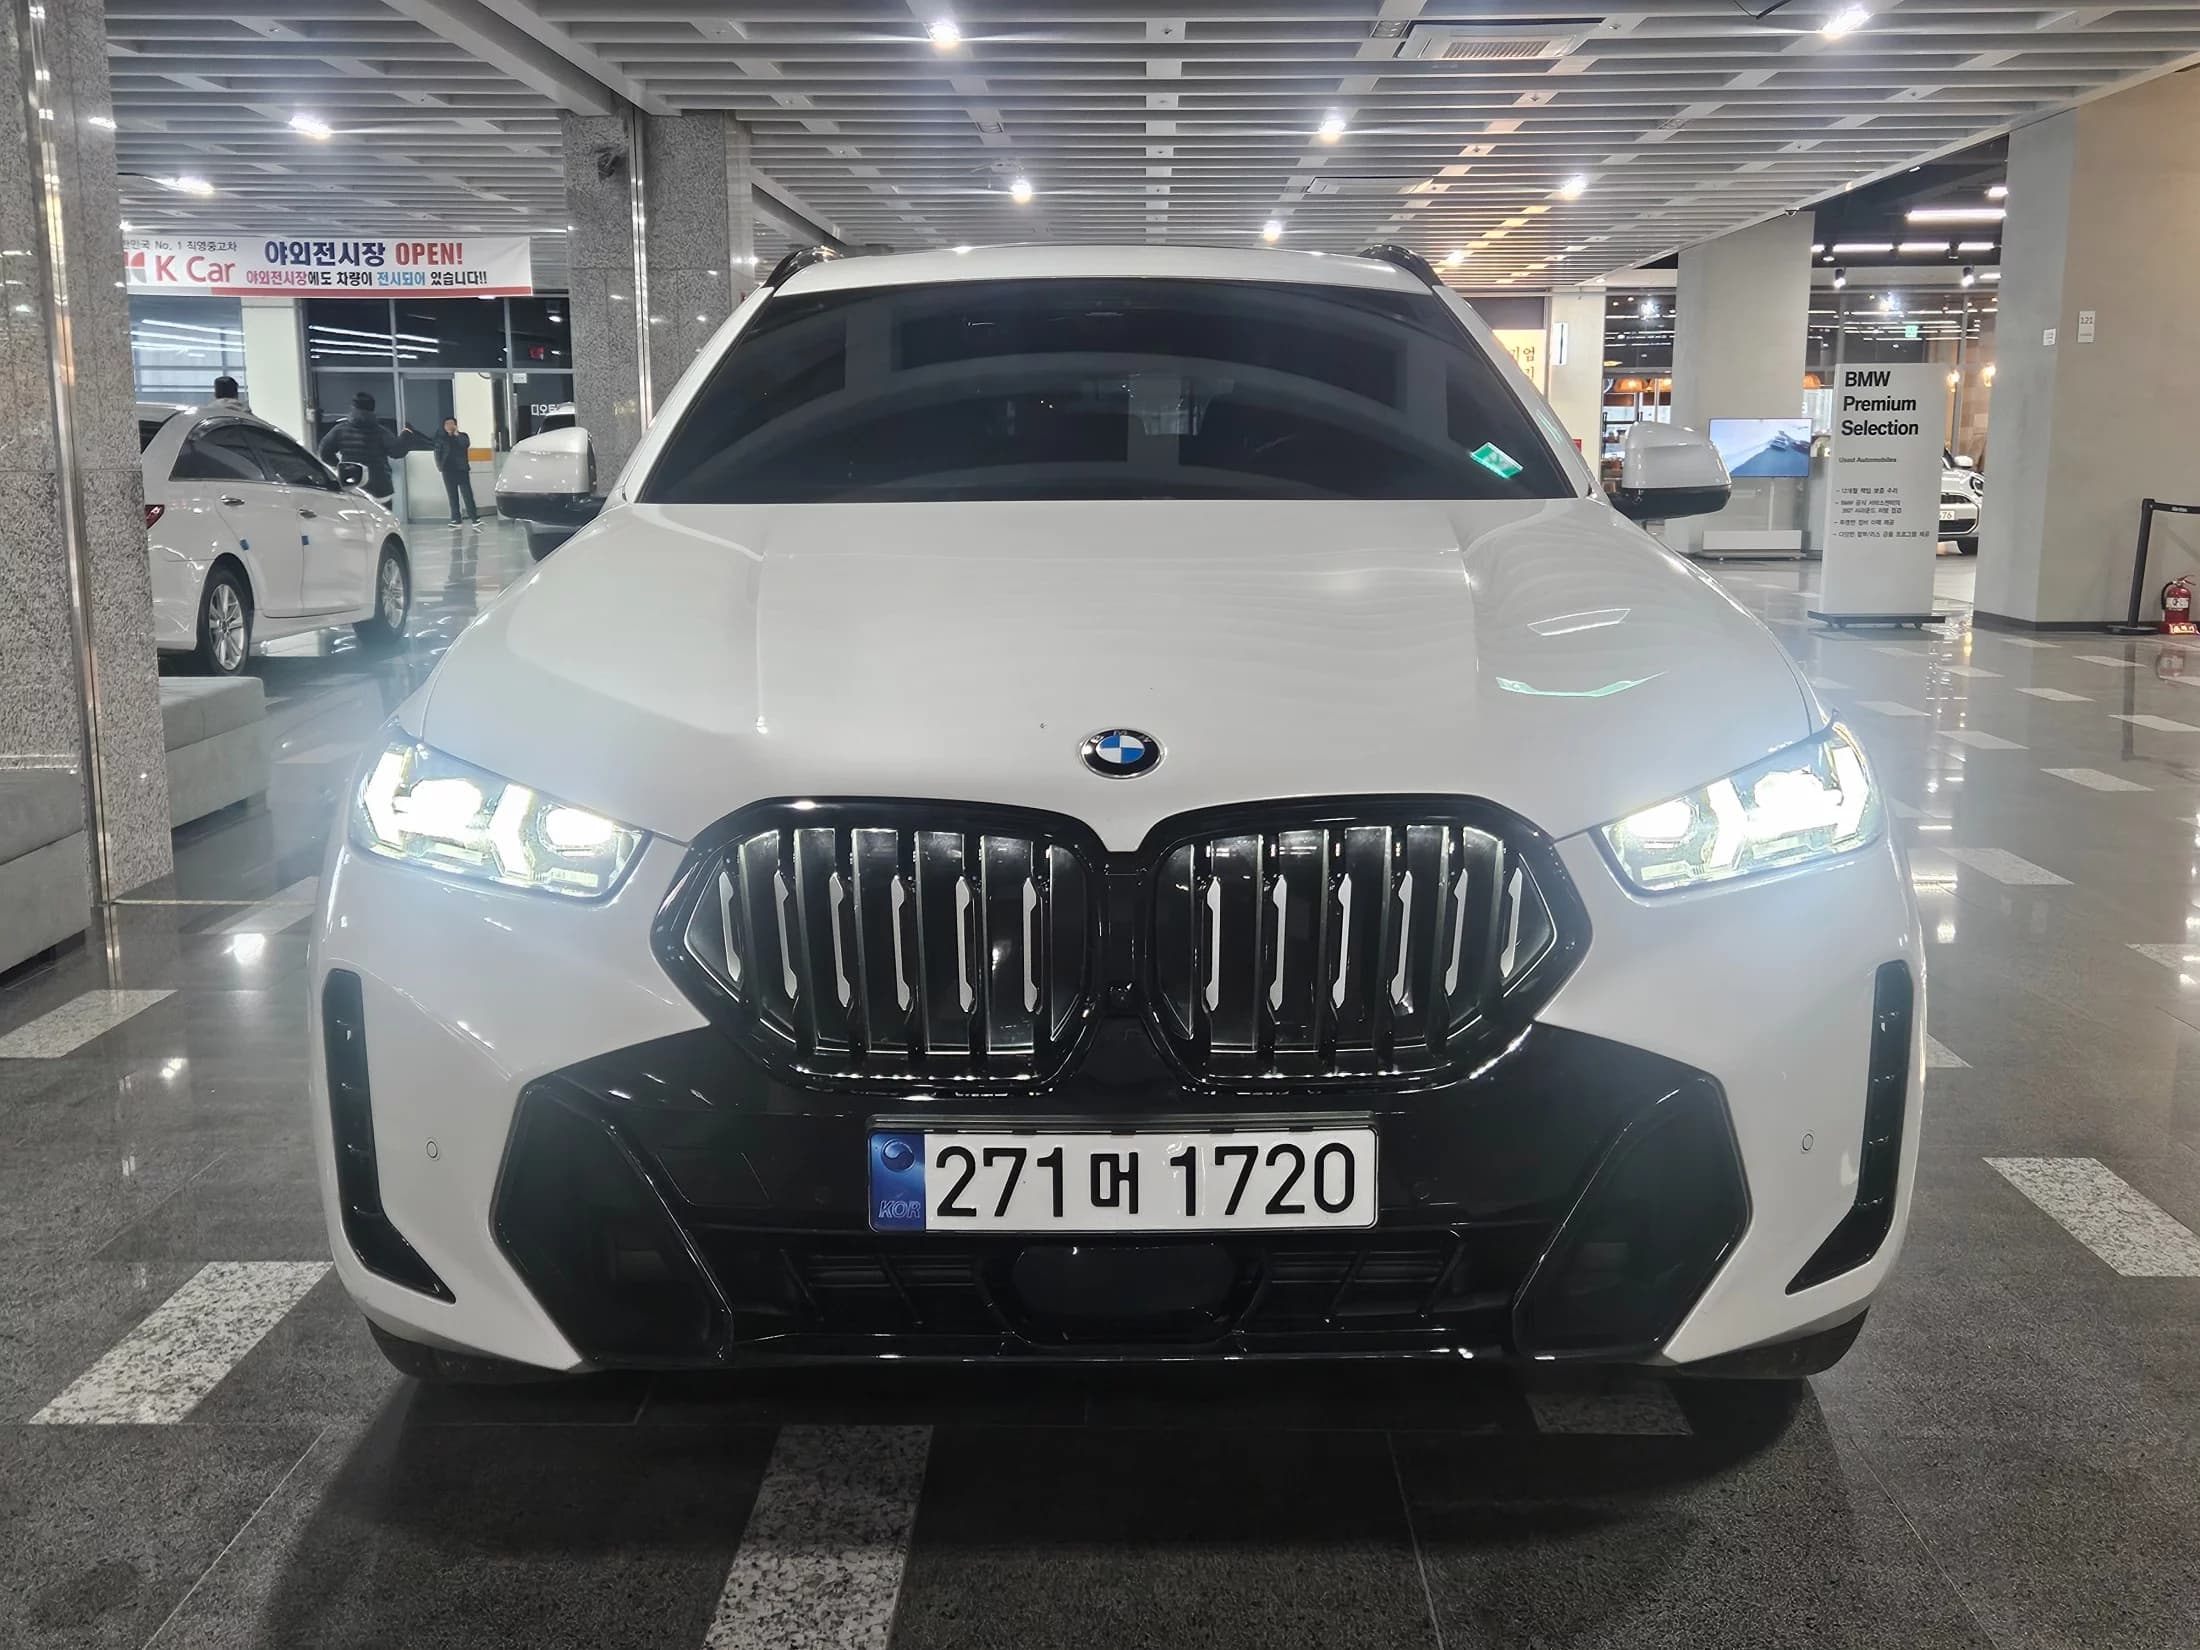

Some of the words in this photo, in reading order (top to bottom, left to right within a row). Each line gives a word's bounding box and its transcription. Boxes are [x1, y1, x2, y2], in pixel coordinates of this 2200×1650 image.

[155, 240, 172, 250] No.
[177, 241, 182, 250] 1
[187, 241, 237, 252] 직영중고차
[264, 241, 386, 267] 야외전시장
[395, 242, 463, 266] OPEN!
[155, 255, 178, 282] K
[186, 256, 235, 282] Car
[246, 270, 332, 286] 야외전시장에도
[337, 271, 373, 286] 차량이
[377, 271, 425, 286] 전시되어
[430, 271, 487, 286] 있습니다!!
[1845, 371, 1891, 387] BMW
[1843, 395, 1917, 411] Premium
[1841, 419, 1919, 435] Selection
[935, 1145, 1064, 1218] 271
[1090, 1150, 1139, 1215] 머
[1169, 1142, 1355, 1216] 1720
[878, 1200, 921, 1218] KOR
